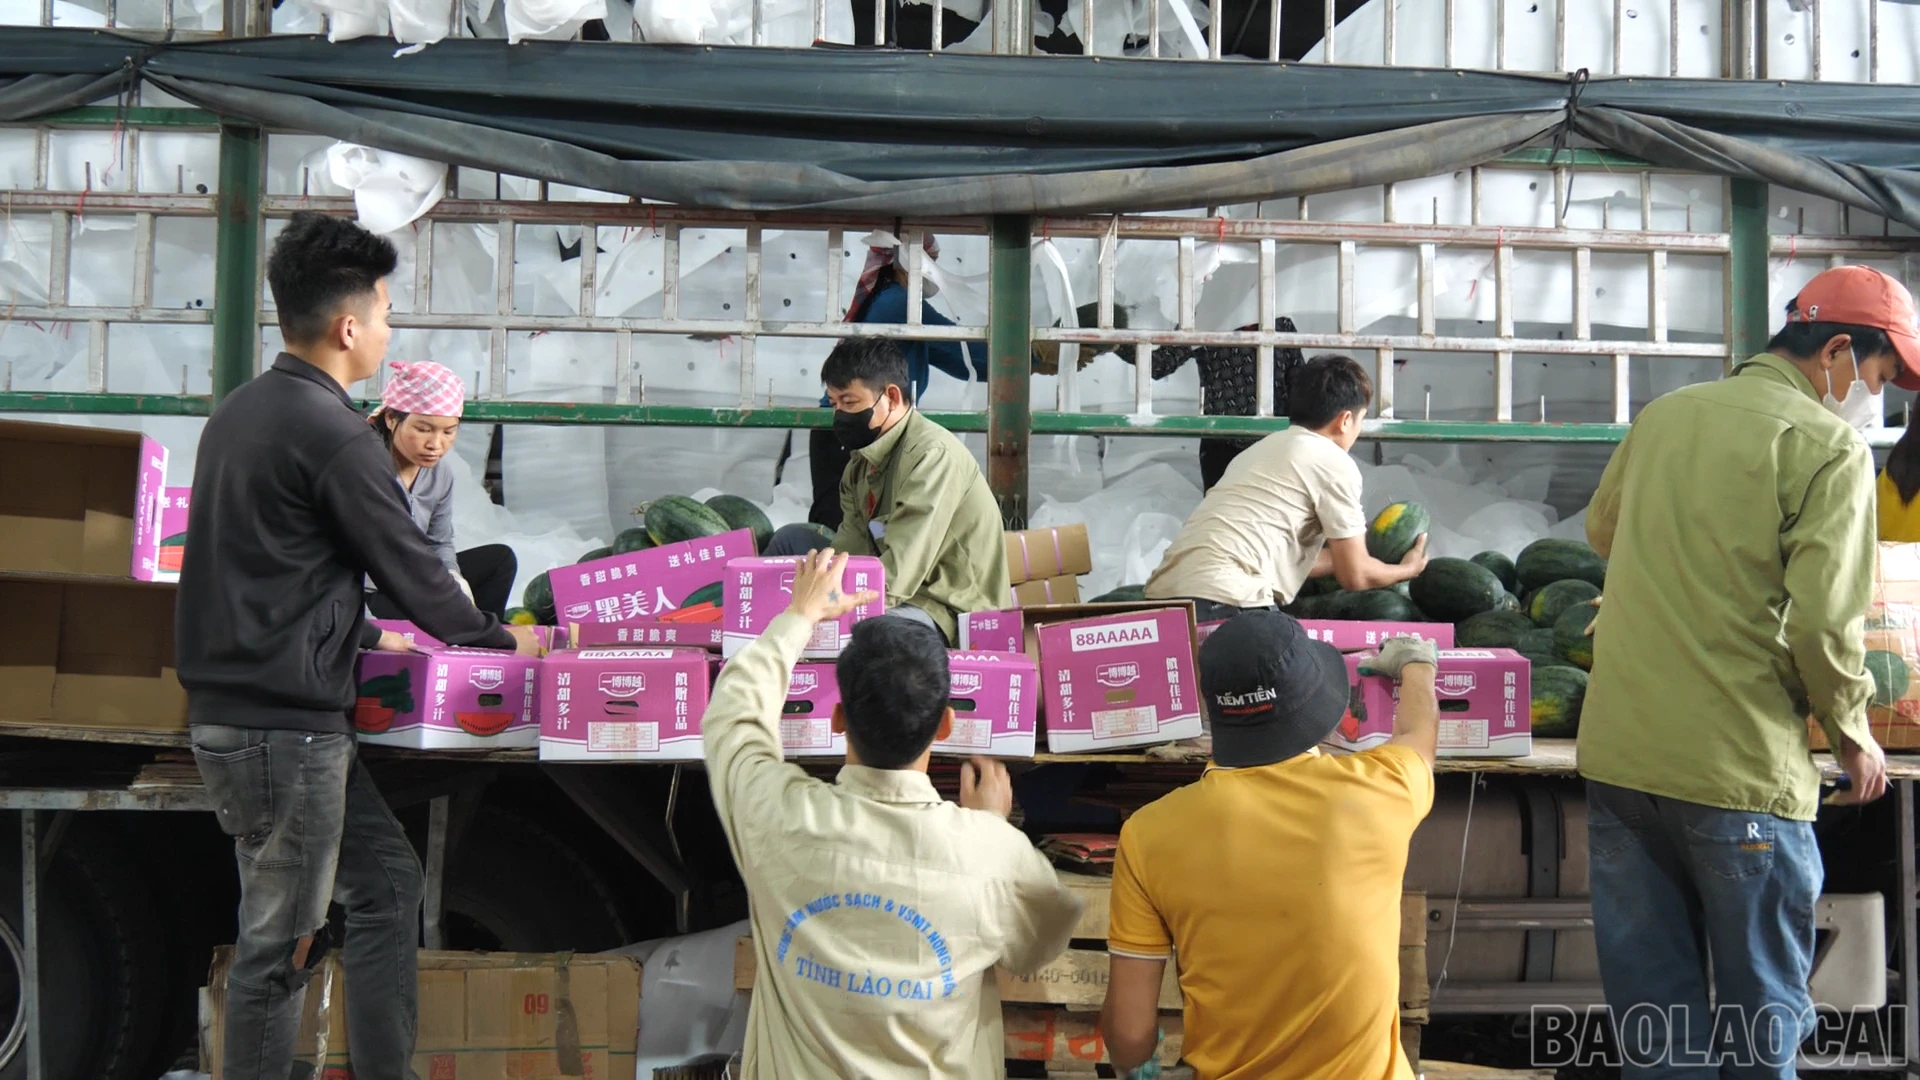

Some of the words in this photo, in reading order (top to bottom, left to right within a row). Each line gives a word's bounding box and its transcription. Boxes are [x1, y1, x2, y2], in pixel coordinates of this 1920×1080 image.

[579, 564, 638, 586] 香甜脆爽
[668, 545, 726, 567] 送礼佳品
[594, 587, 677, 623] 黑美人
[739, 572, 753, 629] 清甜多汁
[617, 628, 677, 642] 香甜脆爽
[1076, 626, 1153, 647] 88AAAAA
[601, 676, 642, 689] 一博博越
[1099, 665, 1136, 679] 一博博越
[433, 664, 449, 721] 清甜多汁
[556, 672, 571, 731] 清甜多汁
[1058, 669, 1075, 723] 清甜多汁
[1747, 821, 1760, 839] R
[844, 892, 881, 910] SẠCH
[884, 899, 894, 912] &
[796, 952, 841, 990] TỈNH
[847, 969, 892, 996] LÀO
[897, 979, 933, 1000] CAI
